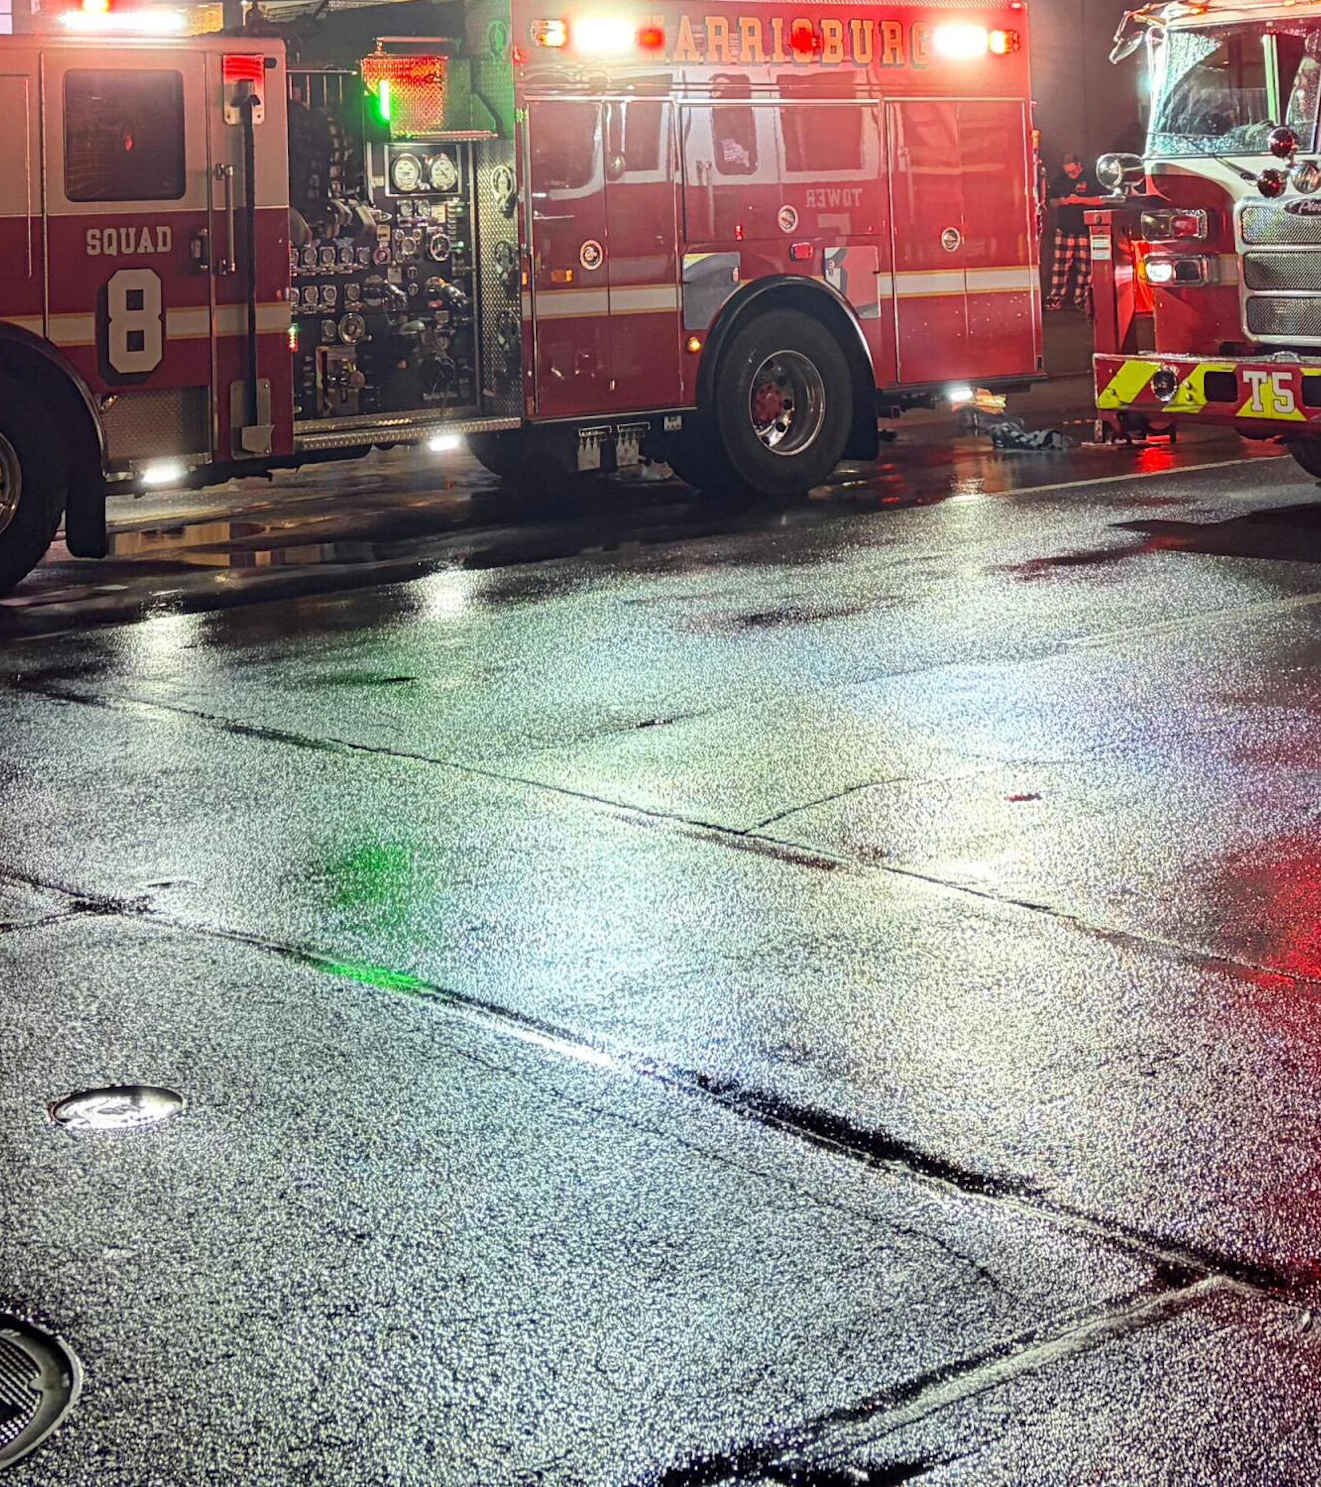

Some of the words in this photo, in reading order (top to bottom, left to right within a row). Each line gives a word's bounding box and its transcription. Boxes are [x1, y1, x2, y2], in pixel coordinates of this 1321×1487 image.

[86, 225, 173, 256] SQUAD
[107, 268, 163, 374] 8
[1242, 370, 1295, 413] T5
